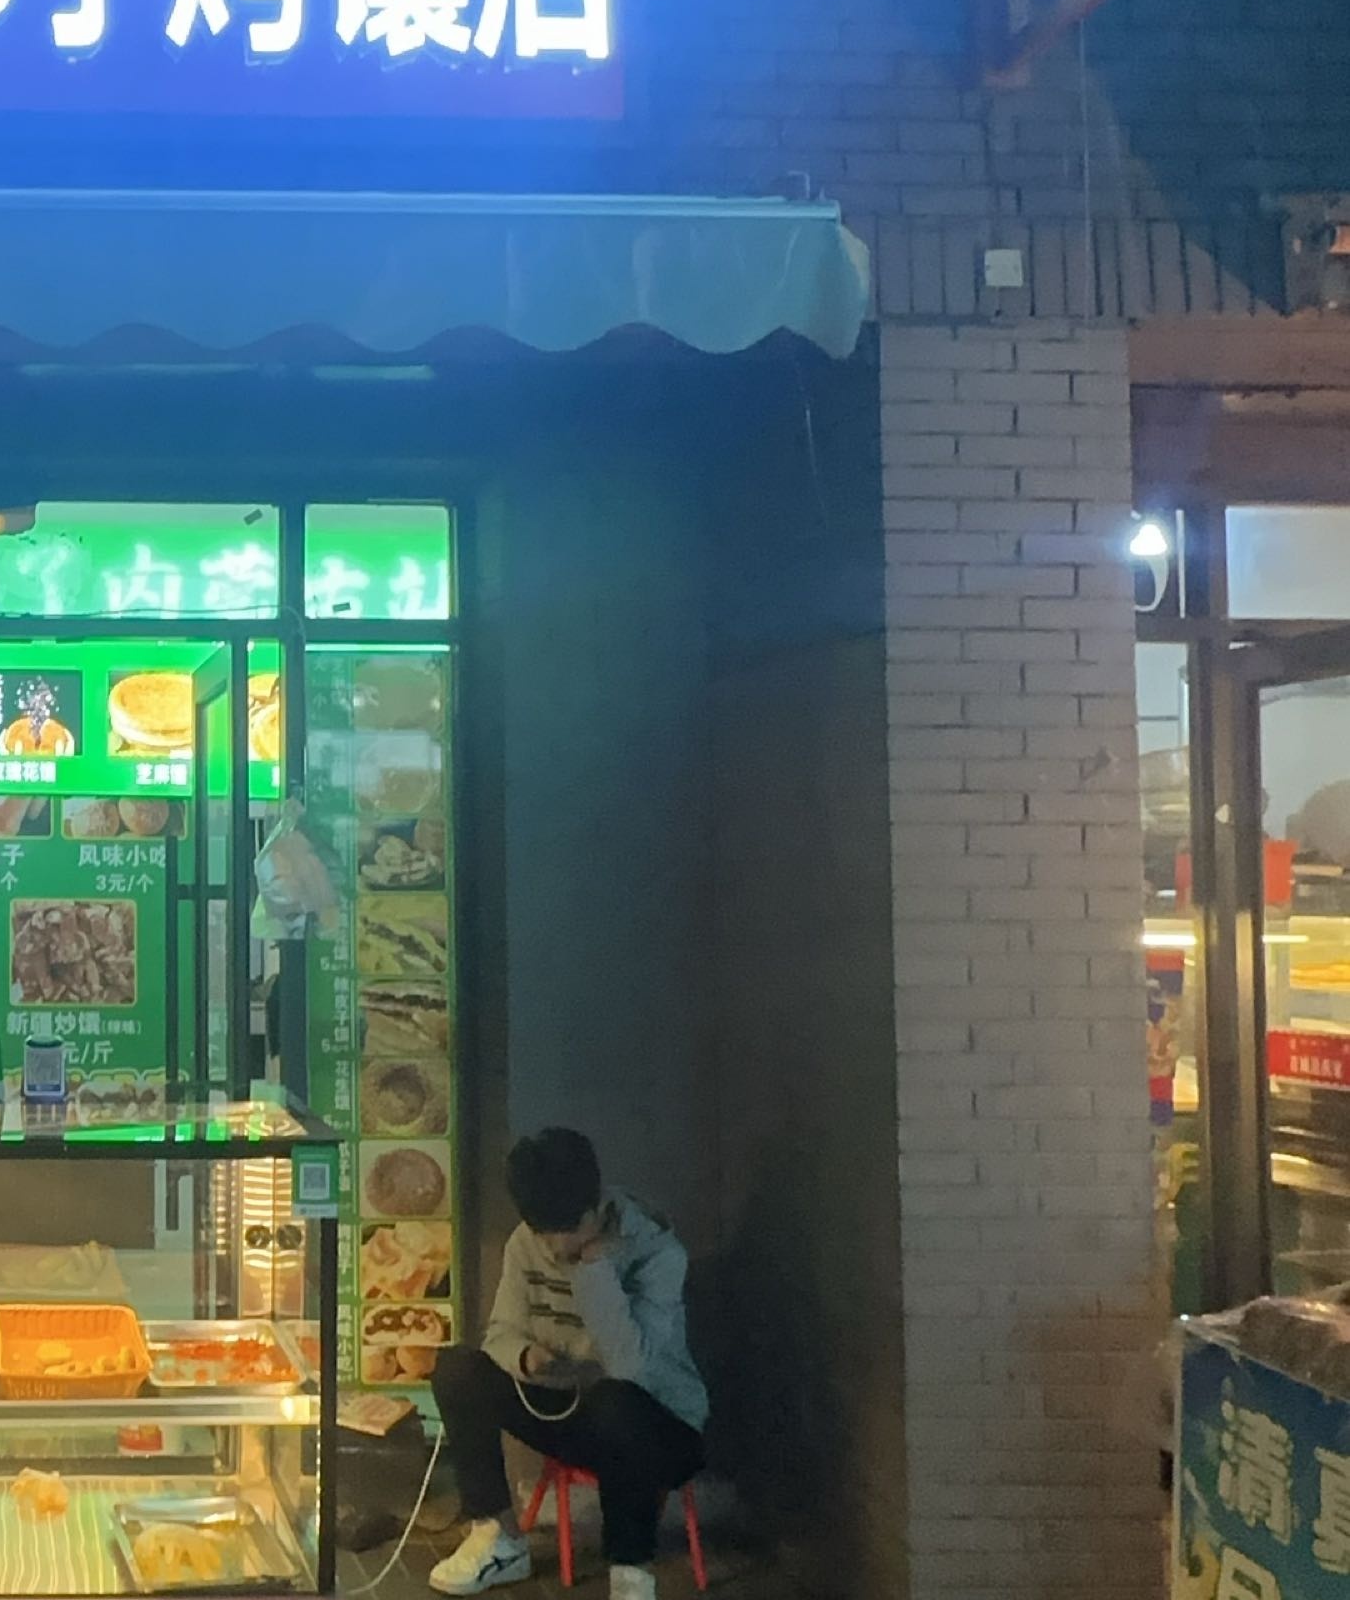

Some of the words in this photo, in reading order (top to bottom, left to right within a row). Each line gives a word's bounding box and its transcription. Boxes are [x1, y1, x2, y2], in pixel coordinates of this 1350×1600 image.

[78, 844, 166, 867] 风味小吃
[96, 873, 154, 892] 3元/个
